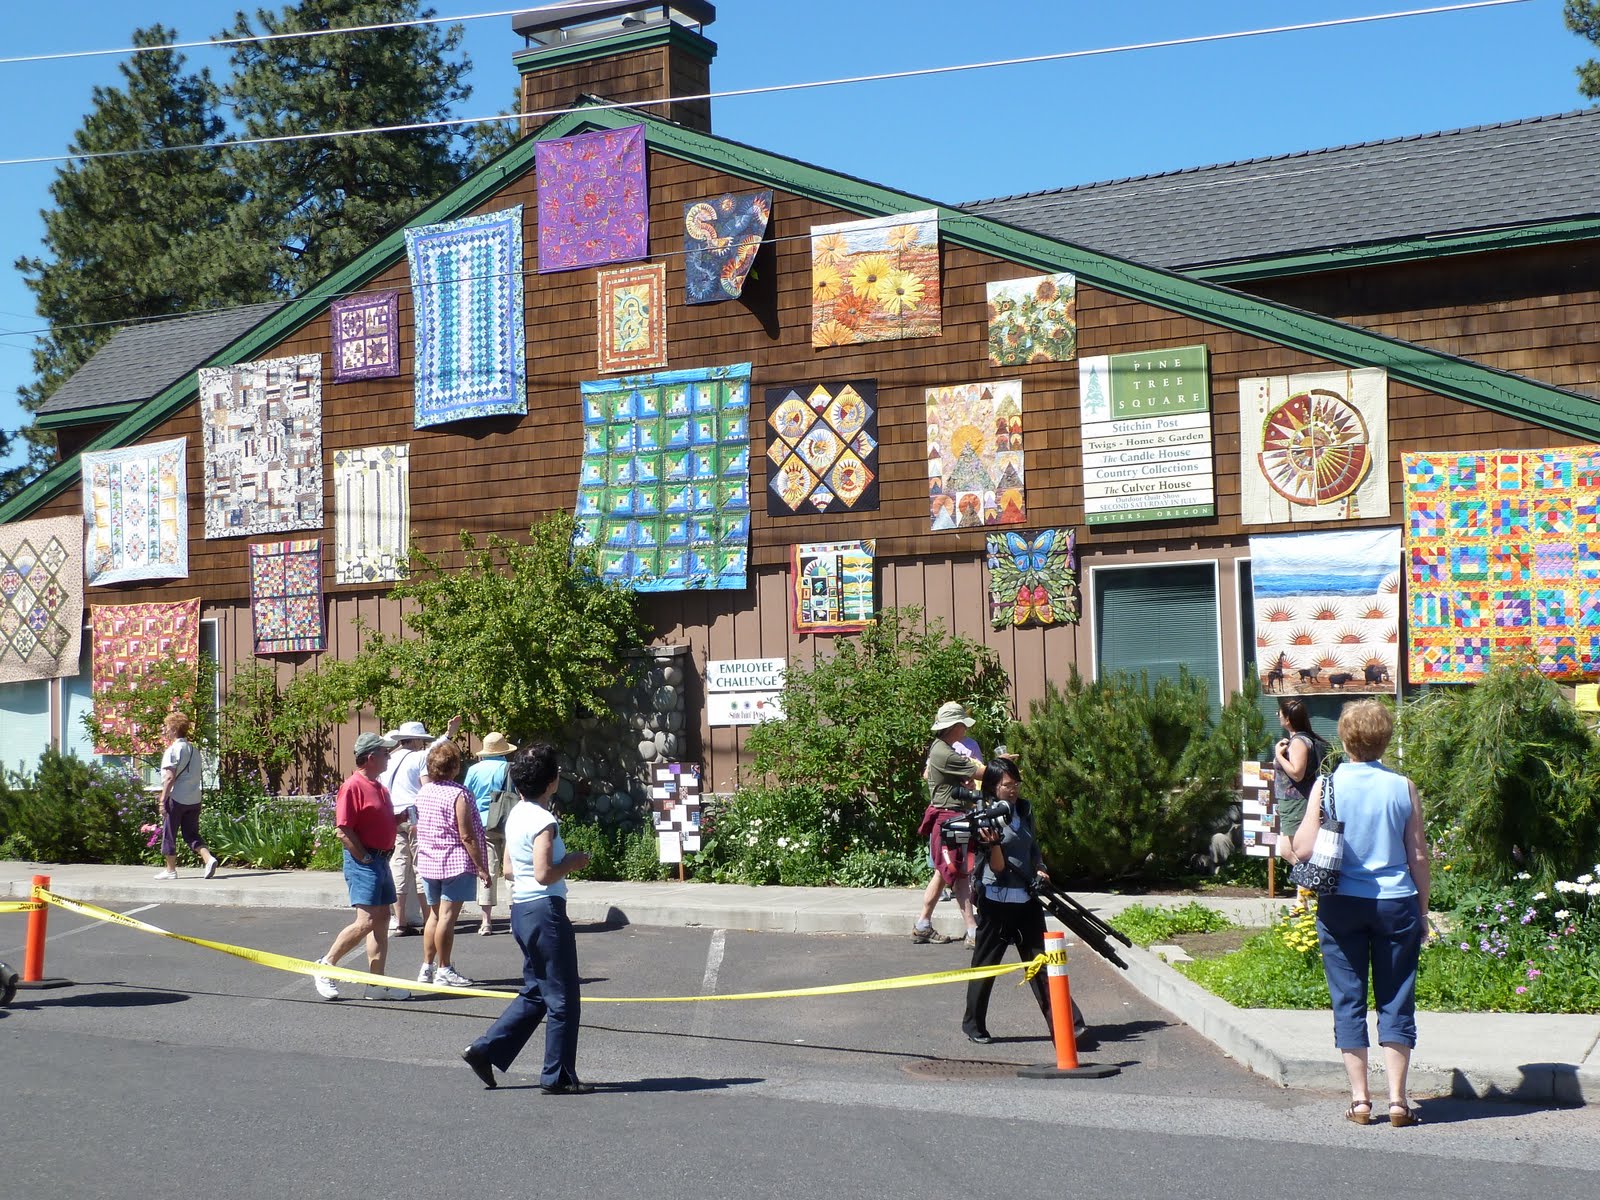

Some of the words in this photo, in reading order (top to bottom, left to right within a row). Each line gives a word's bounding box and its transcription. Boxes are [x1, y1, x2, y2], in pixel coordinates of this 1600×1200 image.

[1134, 359, 1181, 371] PINE
[1133, 377, 1183, 389] TREE
[1119, 393, 1200, 409] SQUARE
[1112, 421, 1152, 433] Stitchin
[1157, 419, 1178, 428] Post
[1088, 440, 1117, 450] Twigs
[1126, 438, 1154, 446] Home
[1168, 432, 1204, 442] Garden
[1103, 454, 1117, 463] The
[1120, 450, 1155, 462] Candle
[1158, 449, 1191, 459] House
[1096, 468, 1138, 479] Country
[1141, 463, 1199, 475] Collections
[1104, 486, 1119, 495] The
[1121, 483, 1156, 494] Culver
[1159, 480, 1192, 490] House
[1099, 503, 1129, 511] SECOND
[1130, 500, 1168, 509] SATURDAY
[1179, 497, 1197, 505] JULY
[1089, 512, 1145, 522] SISTERS,
[1157, 508, 1208, 517] OREGON
[719, 662, 773, 673] EMPLOYEE
[716, 676, 777, 687] CHALLENGE
